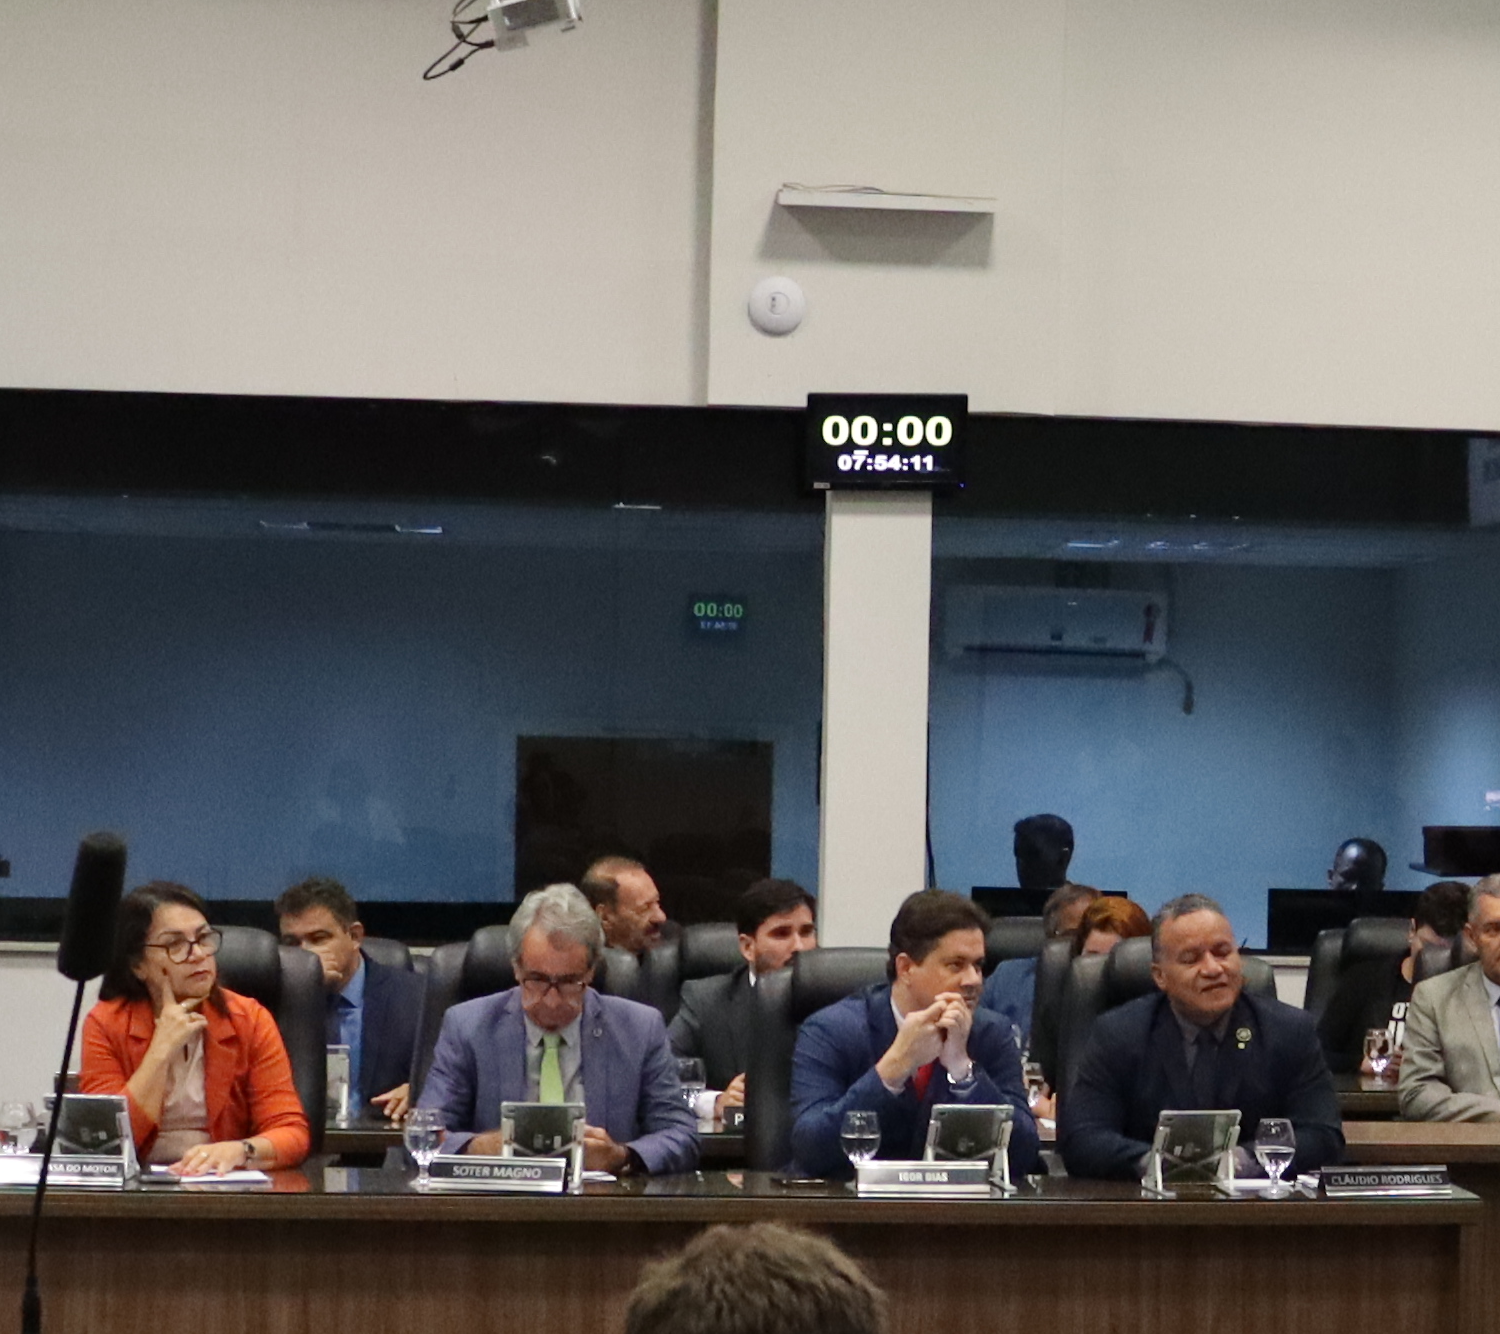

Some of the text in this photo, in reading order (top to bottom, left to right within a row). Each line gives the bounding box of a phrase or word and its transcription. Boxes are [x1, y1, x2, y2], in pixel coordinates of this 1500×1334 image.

[822, 415, 953, 447] 00:00
[837, 452, 934, 471] 07:54:11
[66, 1163, 80, 1173] DO
[82, 1164, 118, 1174] MOTOR
[452, 1165, 542, 1179] SOTER MAGNO
[899, 1171, 948, 1182] IGOR DIAS
[1381, 1173, 1443, 1185] RODRIGUES
